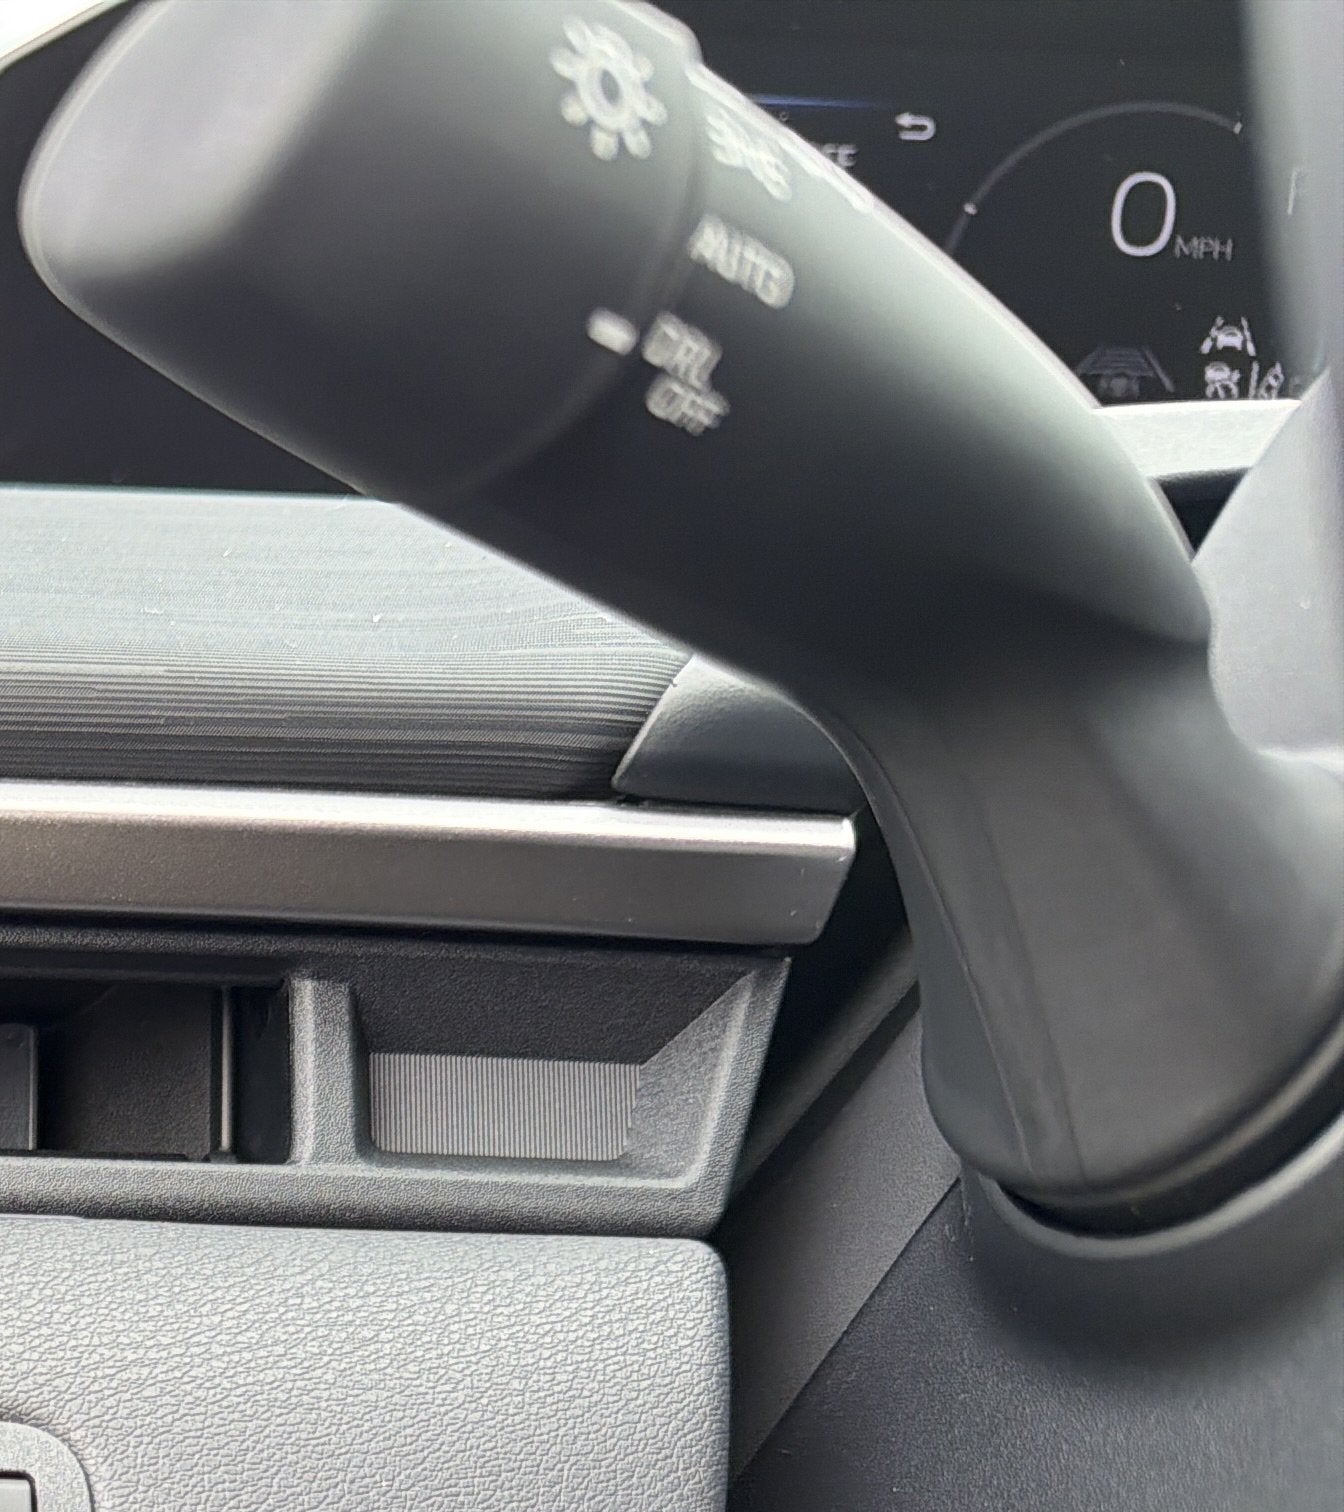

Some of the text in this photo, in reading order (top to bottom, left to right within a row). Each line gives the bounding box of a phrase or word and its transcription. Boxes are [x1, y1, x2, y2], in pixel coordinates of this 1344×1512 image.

[689, 214, 795, 309] AUTO
[1111, 170, 1234, 262] 0 MPH
